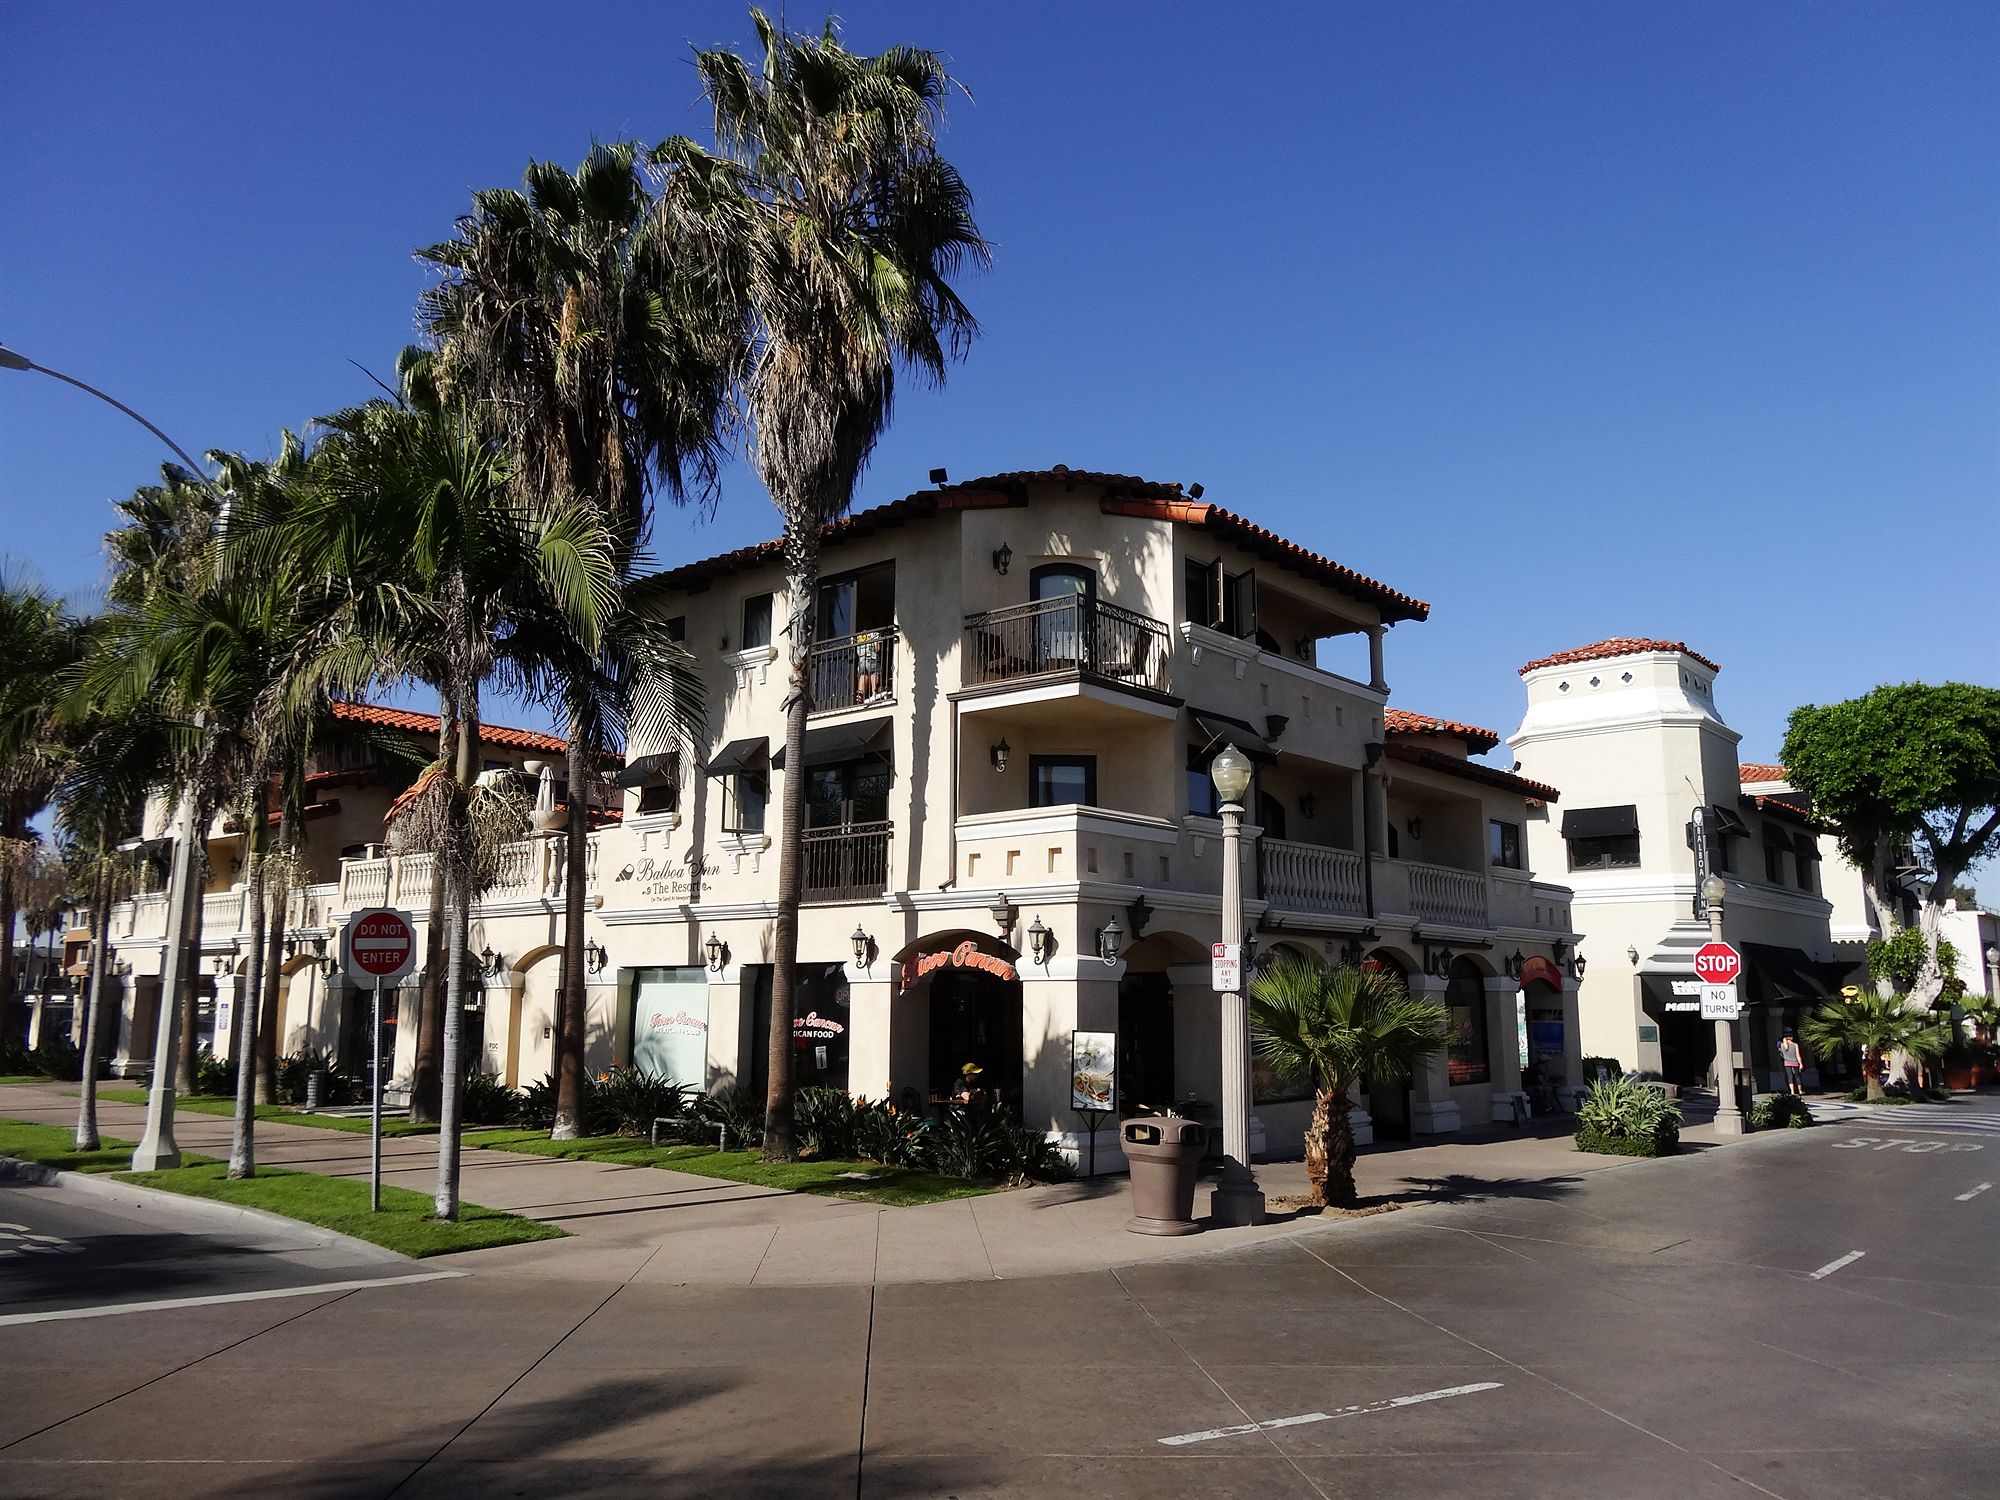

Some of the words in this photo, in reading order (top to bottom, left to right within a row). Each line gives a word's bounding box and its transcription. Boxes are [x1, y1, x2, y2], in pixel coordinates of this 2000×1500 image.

[636, 857, 686, 882] Balboa
[688, 853, 721, 878] Inn
[652, 881, 669, 895] The
[672, 880, 700, 894] Resort
[360, 924, 377, 935] DO
[381, 924, 403, 935] NOT
[1215, 945, 1224, 956] NO
[362, 952, 400, 963] ENTER
[898, 951, 949, 996] Tacos
[952, 940, 1016, 981] Cancun
[1215, 960, 1237, 968] STOPPING
[1697, 955, 1738, 972] STOP
[1711, 990, 1726, 1000] NO
[1703, 1004, 1735, 1014] TURNS
[806, 1011, 845, 1034] Cancun
[793, 1030, 812, 1038] ICAN
[813, 1030, 834, 1039] FOOD
[1832, 1137, 1985, 1153] STOP
